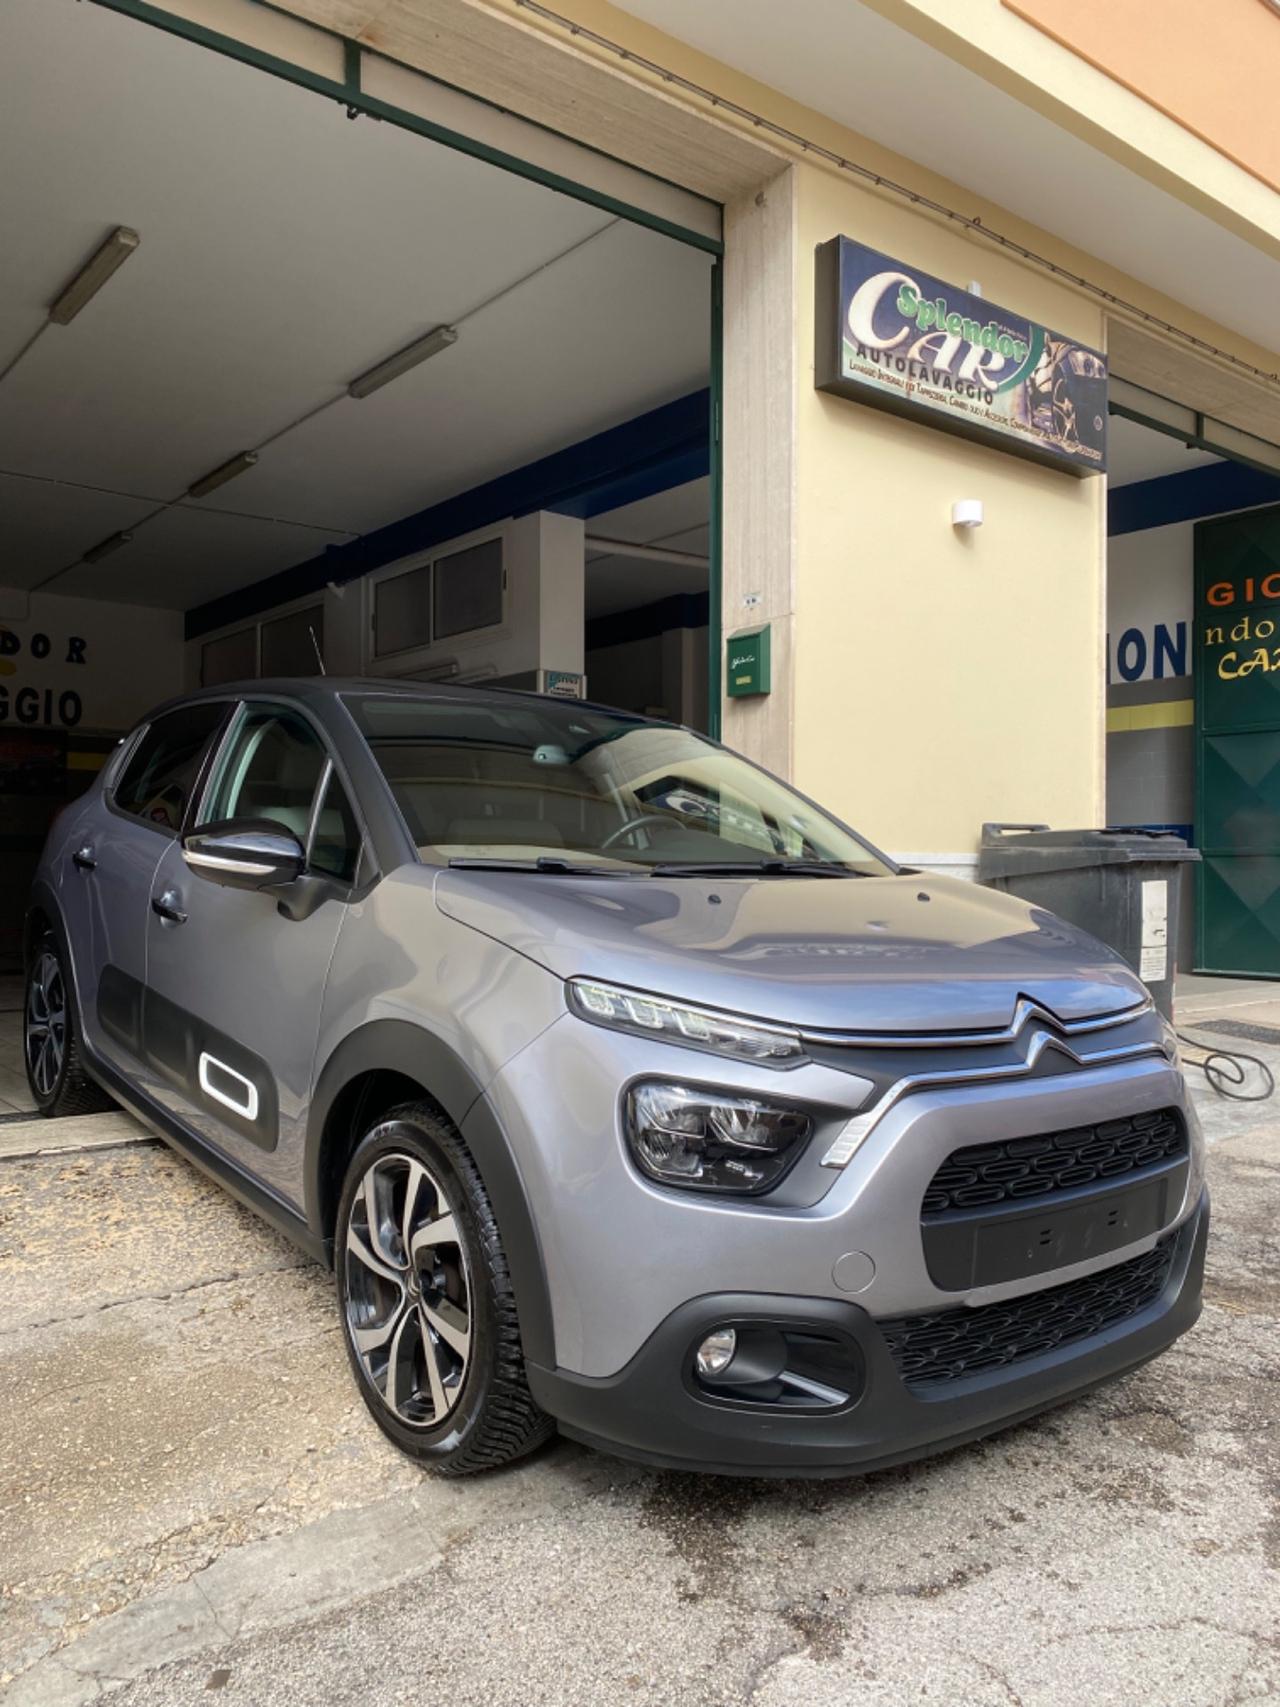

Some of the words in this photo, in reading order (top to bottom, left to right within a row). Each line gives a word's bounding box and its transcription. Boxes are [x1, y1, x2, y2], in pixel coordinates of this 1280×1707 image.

[848, 271, 1006, 390] CAR
[896, 283, 1029, 364] Splendor
[856, 343, 995, 406] AUTOLAVAGGIO
[1204, 616, 1275, 646] ndo
